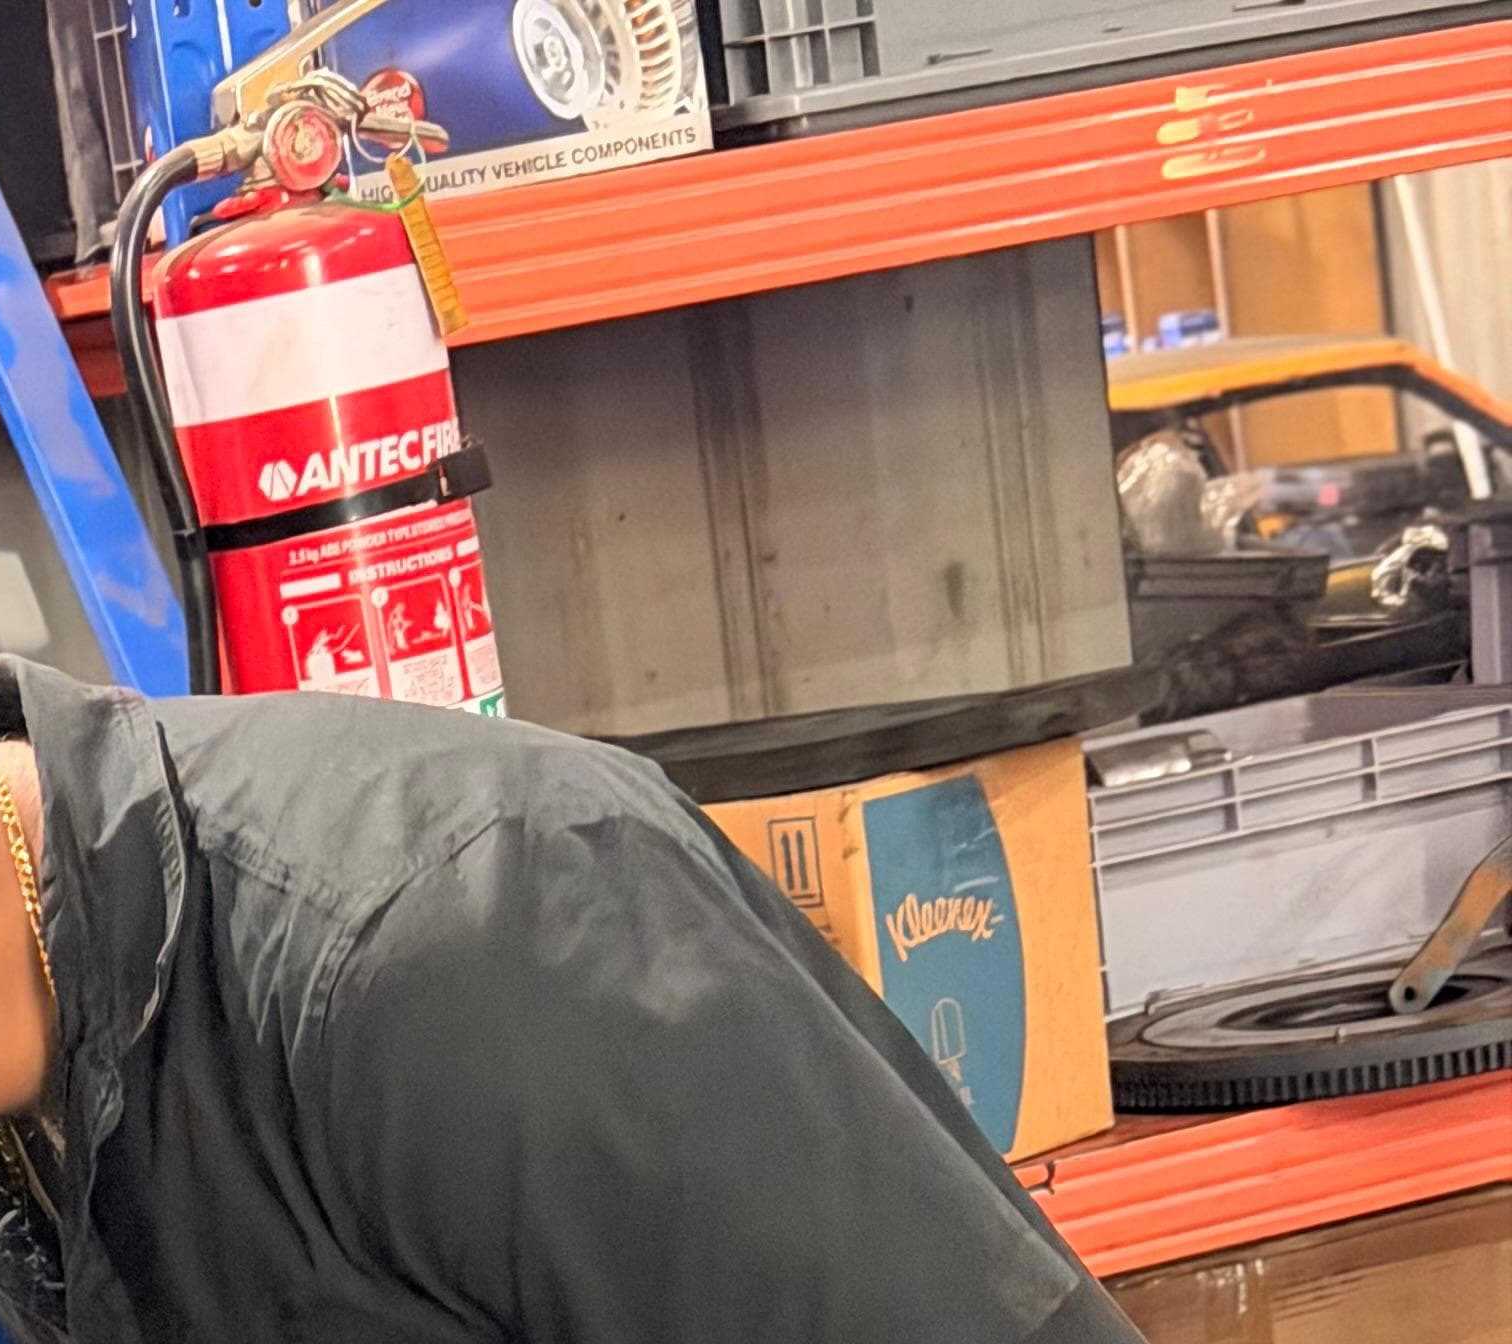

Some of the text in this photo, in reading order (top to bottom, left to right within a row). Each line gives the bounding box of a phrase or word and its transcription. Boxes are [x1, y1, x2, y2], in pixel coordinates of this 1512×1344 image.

[361, 127, 696, 204] HIG UALITY VEHICLE COMPONENTS
[885, 893, 996, 962] Kleenex
